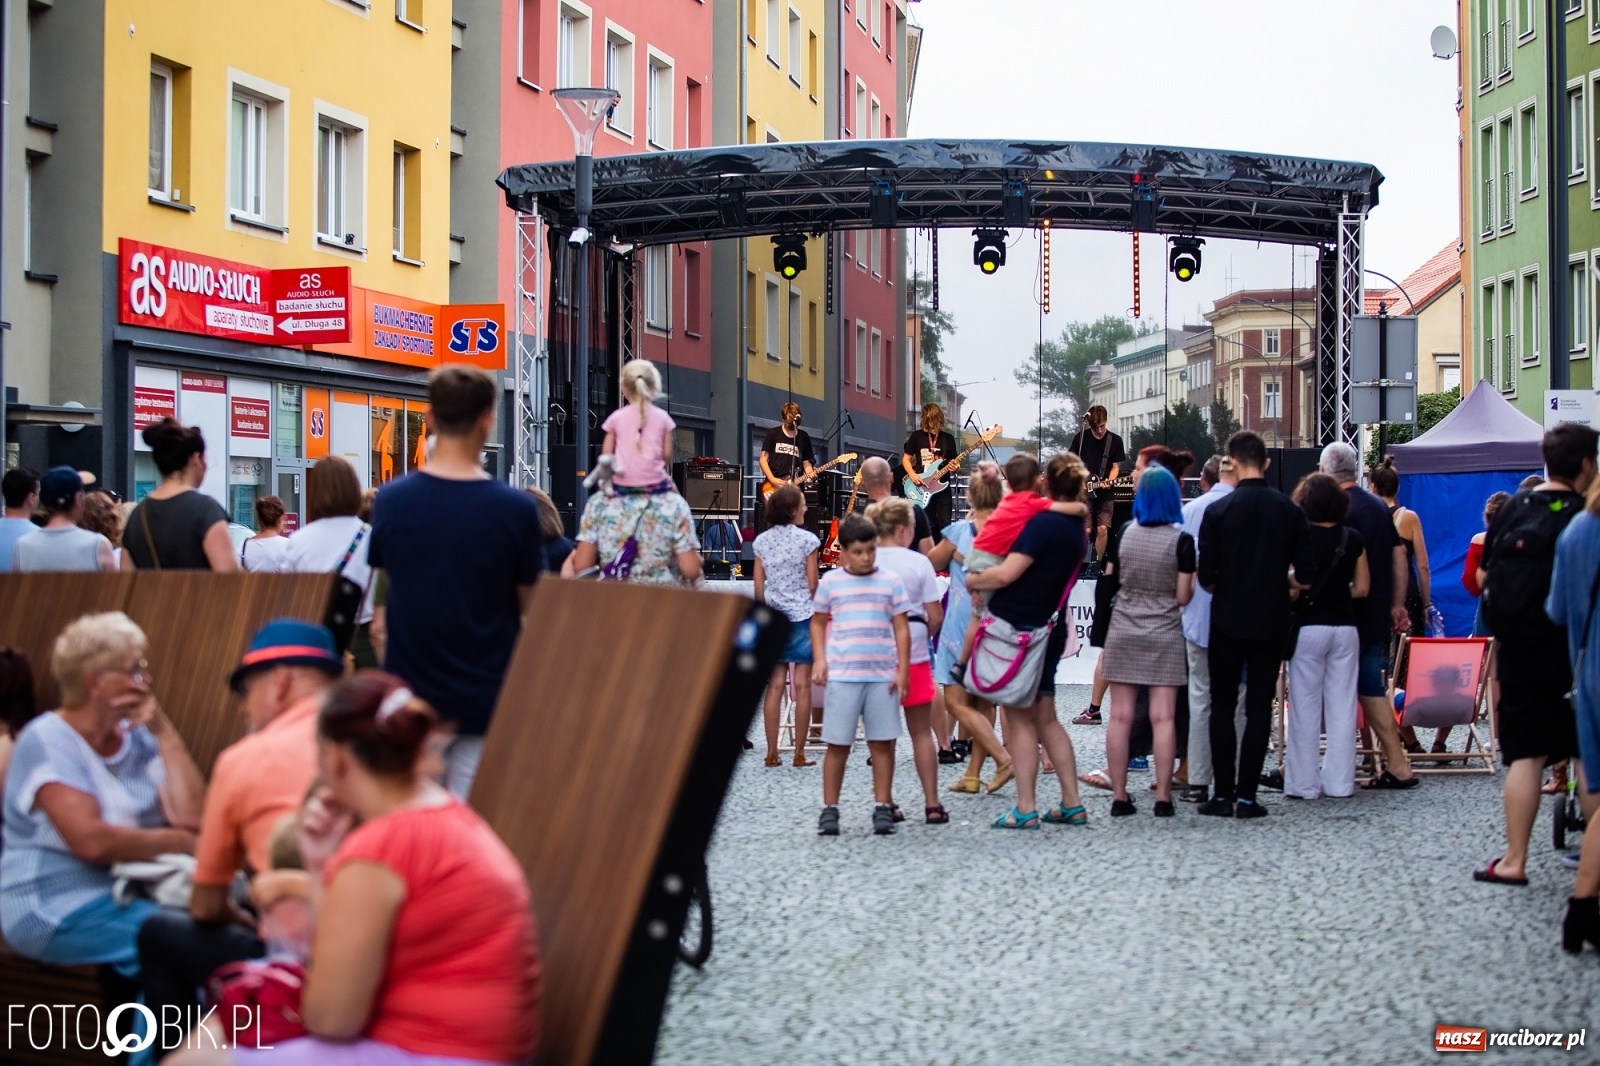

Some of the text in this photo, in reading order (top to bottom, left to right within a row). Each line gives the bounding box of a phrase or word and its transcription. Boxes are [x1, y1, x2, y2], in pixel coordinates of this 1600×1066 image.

[130, 252, 167, 318] as
[168, 259, 261, 305] AUDIO-SŁUCH
[299, 273, 322, 289] as
[279, 300, 343, 311] badanie słuchu
[286, 290, 335, 298] AUDIO-SŁUCH
[213, 310, 269, 331] aparaty słuchowe
[291, 318, 343, 330] ul. Długa 48
[374, 304, 434, 335] BUKMACHERSKIE
[374, 329, 434, 356] ZAKŁADY SPORTOWE
[448, 318, 499, 354] STS
